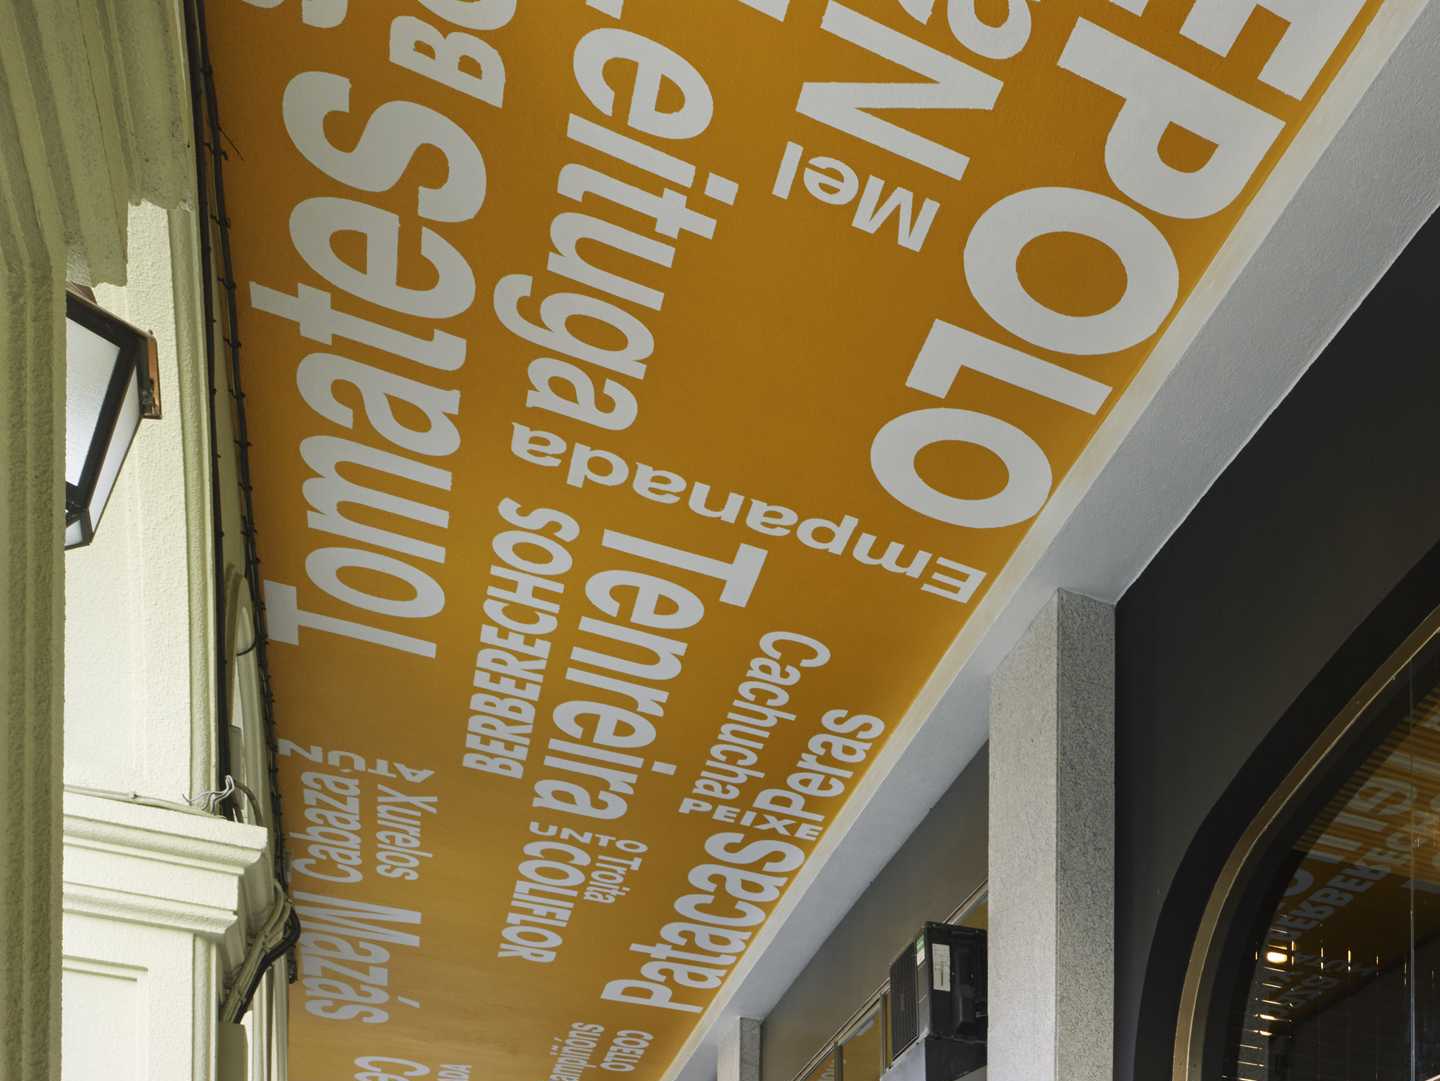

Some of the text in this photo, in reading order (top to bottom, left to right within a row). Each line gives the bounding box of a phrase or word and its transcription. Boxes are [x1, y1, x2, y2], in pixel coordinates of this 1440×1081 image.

[493, 0, 790, 430] eituga
[772, 141, 940, 253] Mel
[249, 71, 487, 659] Tomates
[508, 422, 988, 605] Empanada
[462, 496, 581, 780] BERBERECHOS
[532, 529, 769, 820] Tenreira
[278, 738, 435, 783] ATÚN
[695, 631, 831, 804] Cachucha
[752, 708, 885, 825] Peras
[289, 769, 362, 884] Cabaza
[376, 780, 439, 882] Xurelos
[530, 822, 648, 853] UNTO
[584, 855, 641, 904] Troita
[678, 798, 825, 841] PEIXE
[295, 890, 421, 1024] Mazás
[498, 840, 587, 963] COLIFLOR
[601, 831, 807, 1013] Patacas
[600, 1029, 654, 1073] COELLO
